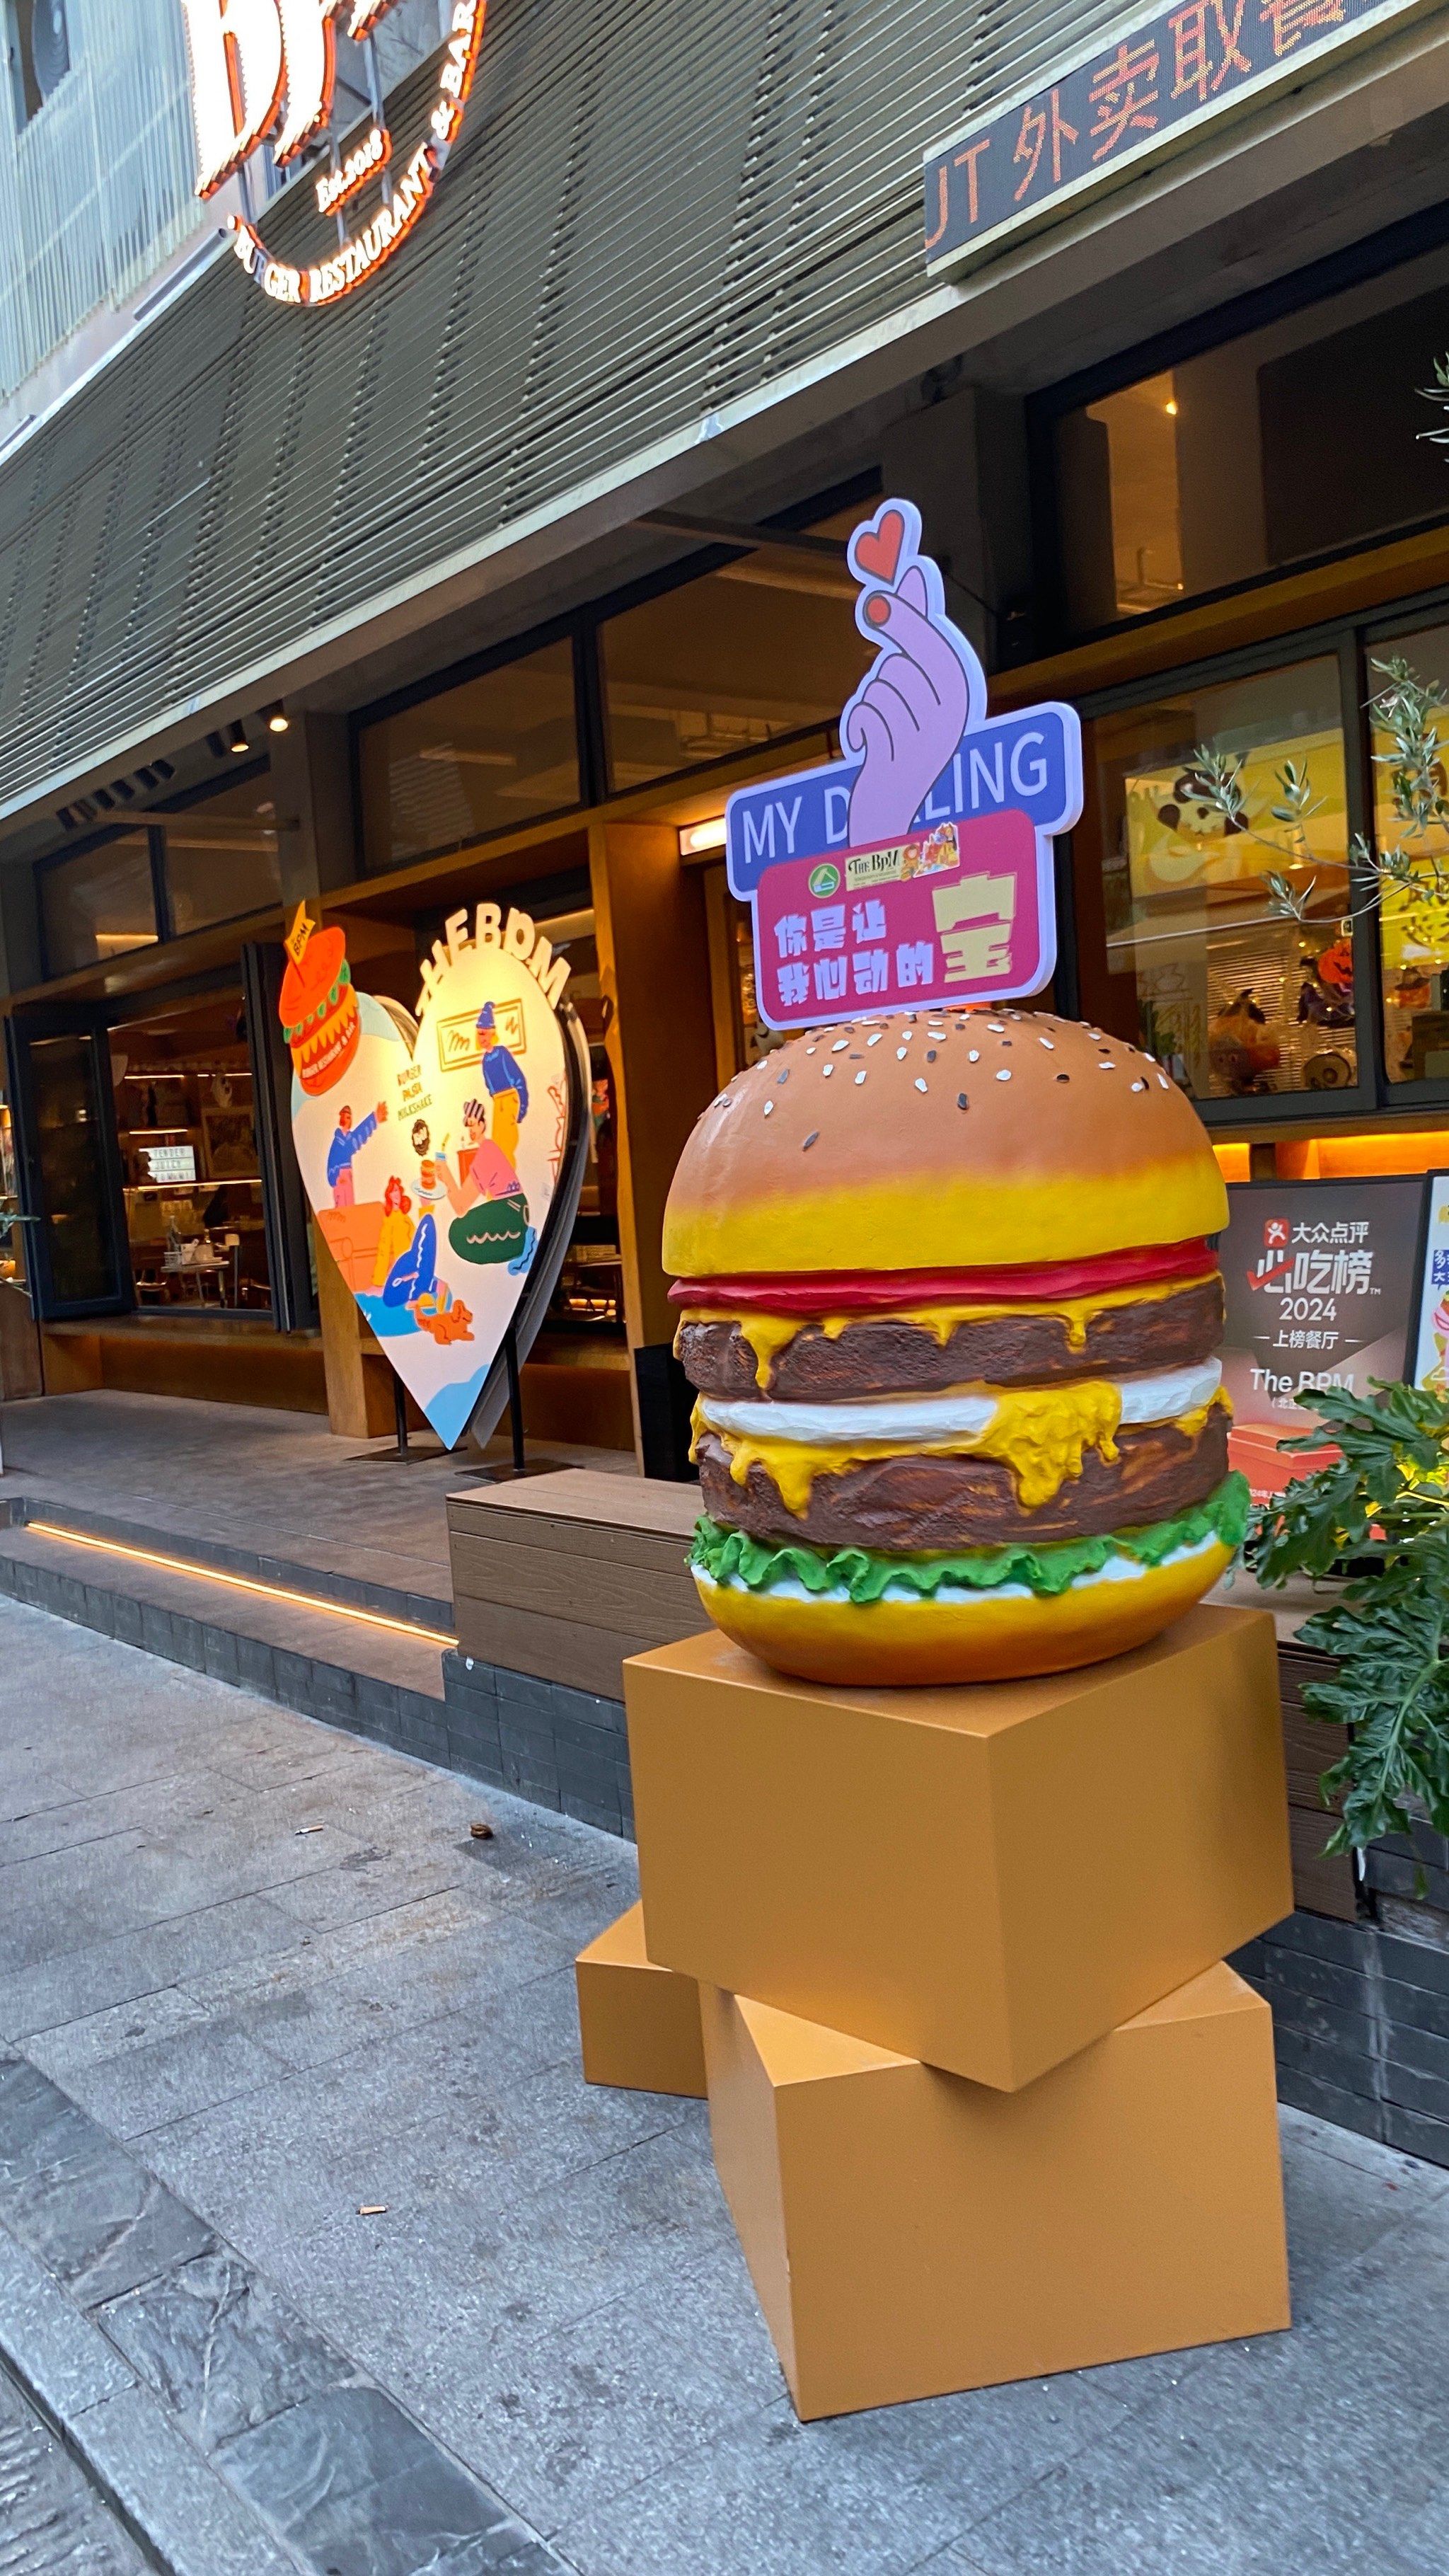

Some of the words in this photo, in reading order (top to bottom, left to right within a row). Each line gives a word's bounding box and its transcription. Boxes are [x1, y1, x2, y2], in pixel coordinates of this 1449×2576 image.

[308, 142, 432, 303] RESTAURANT
[439, 0, 478, 98] BAR
[741, 795, 803, 864] MY
[824, 730, 1049, 844] DLING
[773, 899, 887, 959] 你是让
[776, 940, 934, 1006] 我心动的
[1291, 1221, 1370, 1244] 大众点评
[1247, 1249, 1373, 1295] 必吃榜
[1278, 1297, 1337, 1321] 2024
[1273, 1330, 1339, 1350] 上榜餐厅
[1249, 1368, 1293, 1393] The
